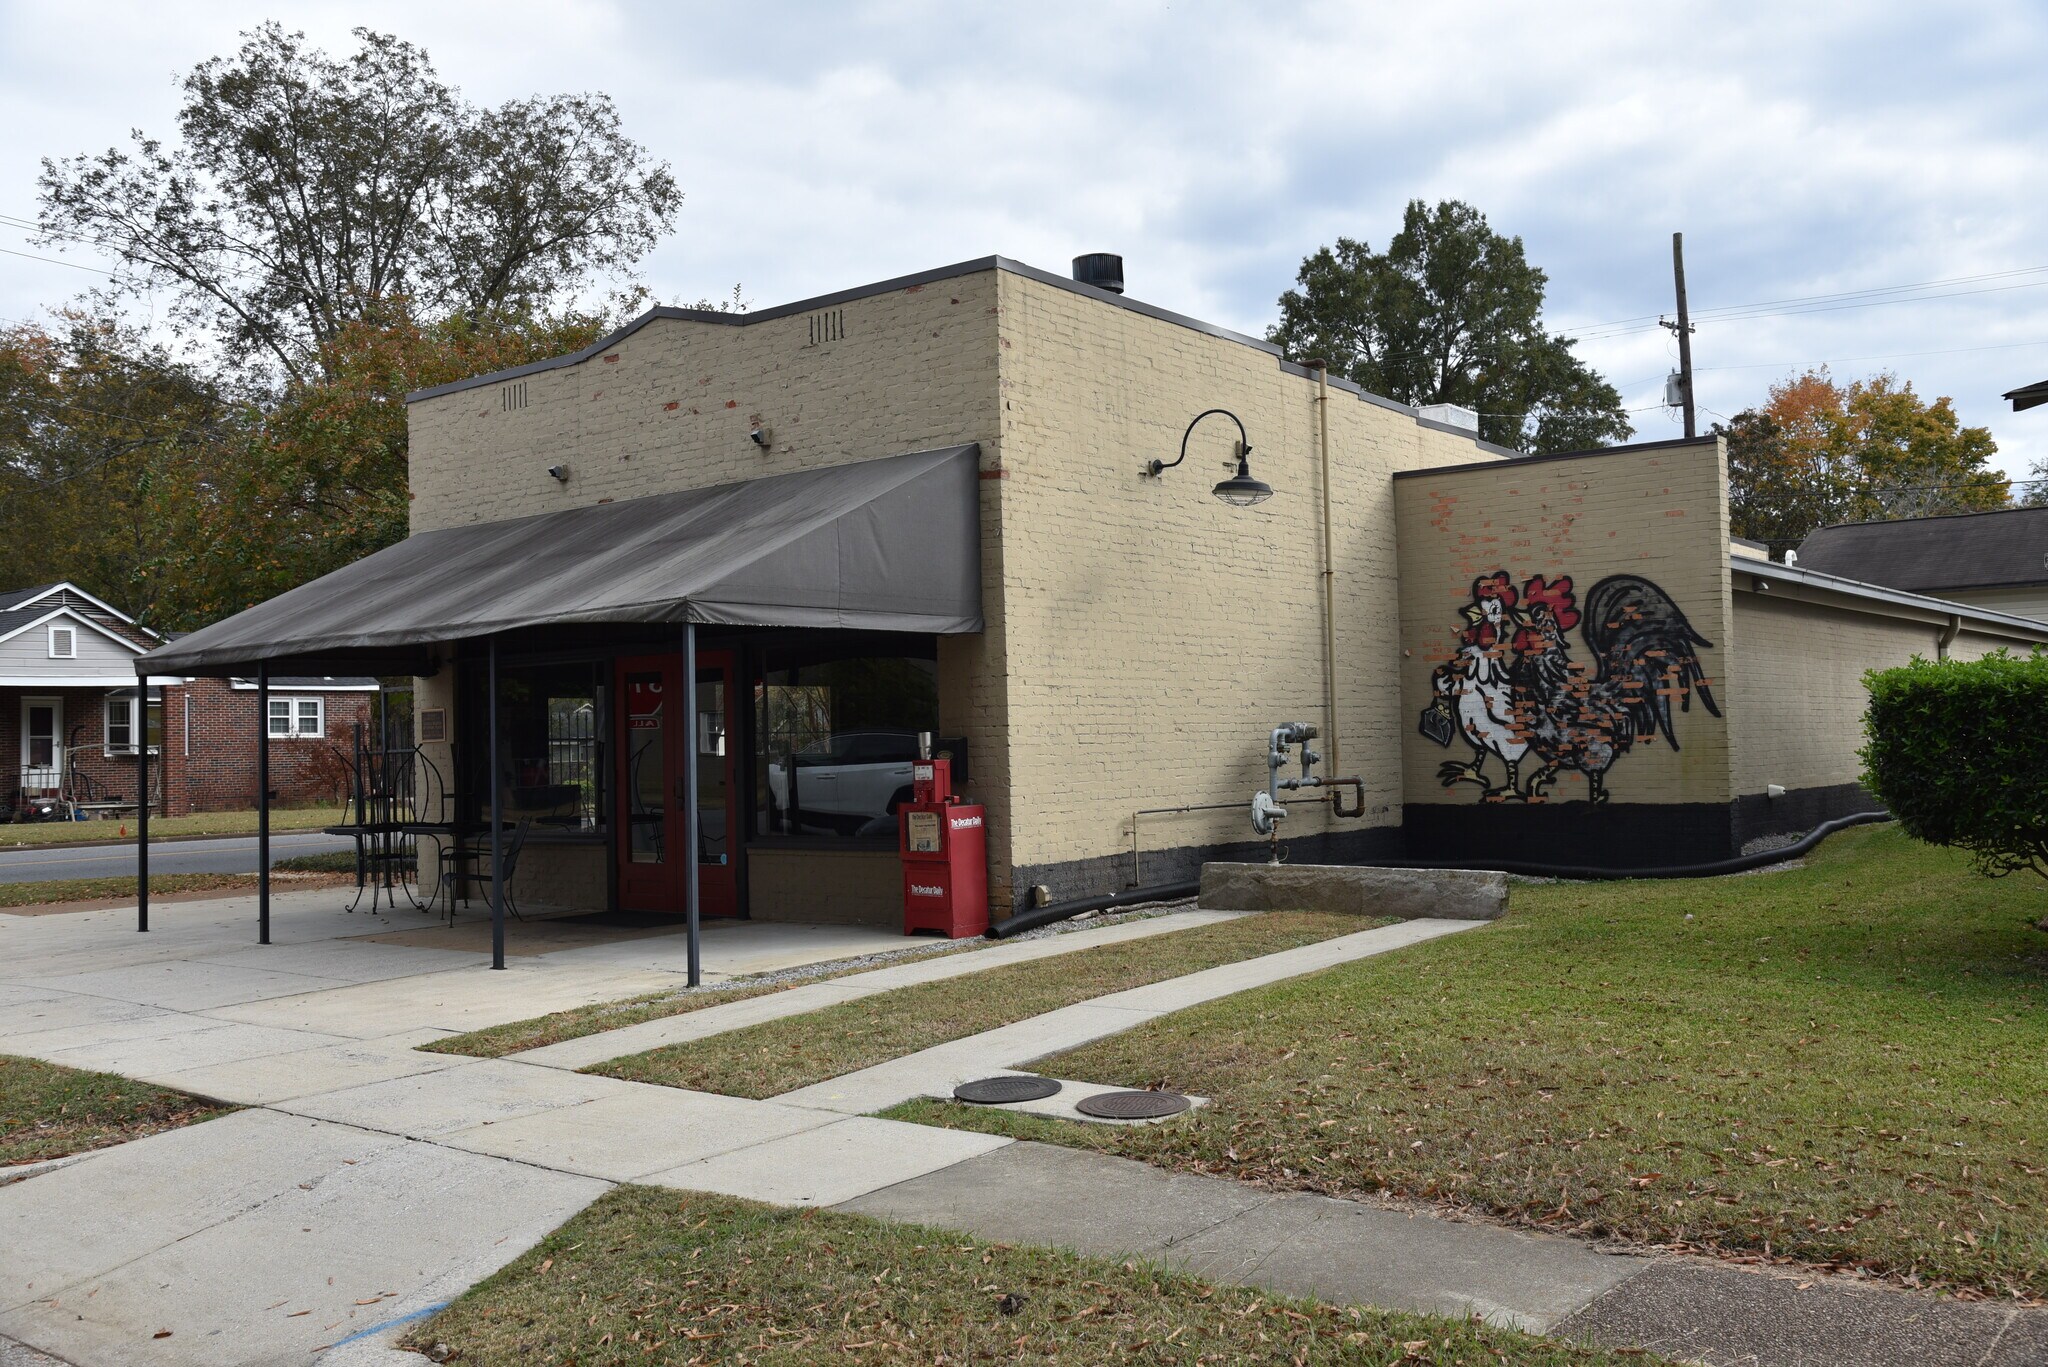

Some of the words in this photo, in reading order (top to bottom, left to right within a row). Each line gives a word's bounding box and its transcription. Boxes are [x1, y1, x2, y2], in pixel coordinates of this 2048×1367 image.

[972, 816, 982, 826] Daily
[911, 884, 919, 894] The
[933, 886, 943, 896] Daily
